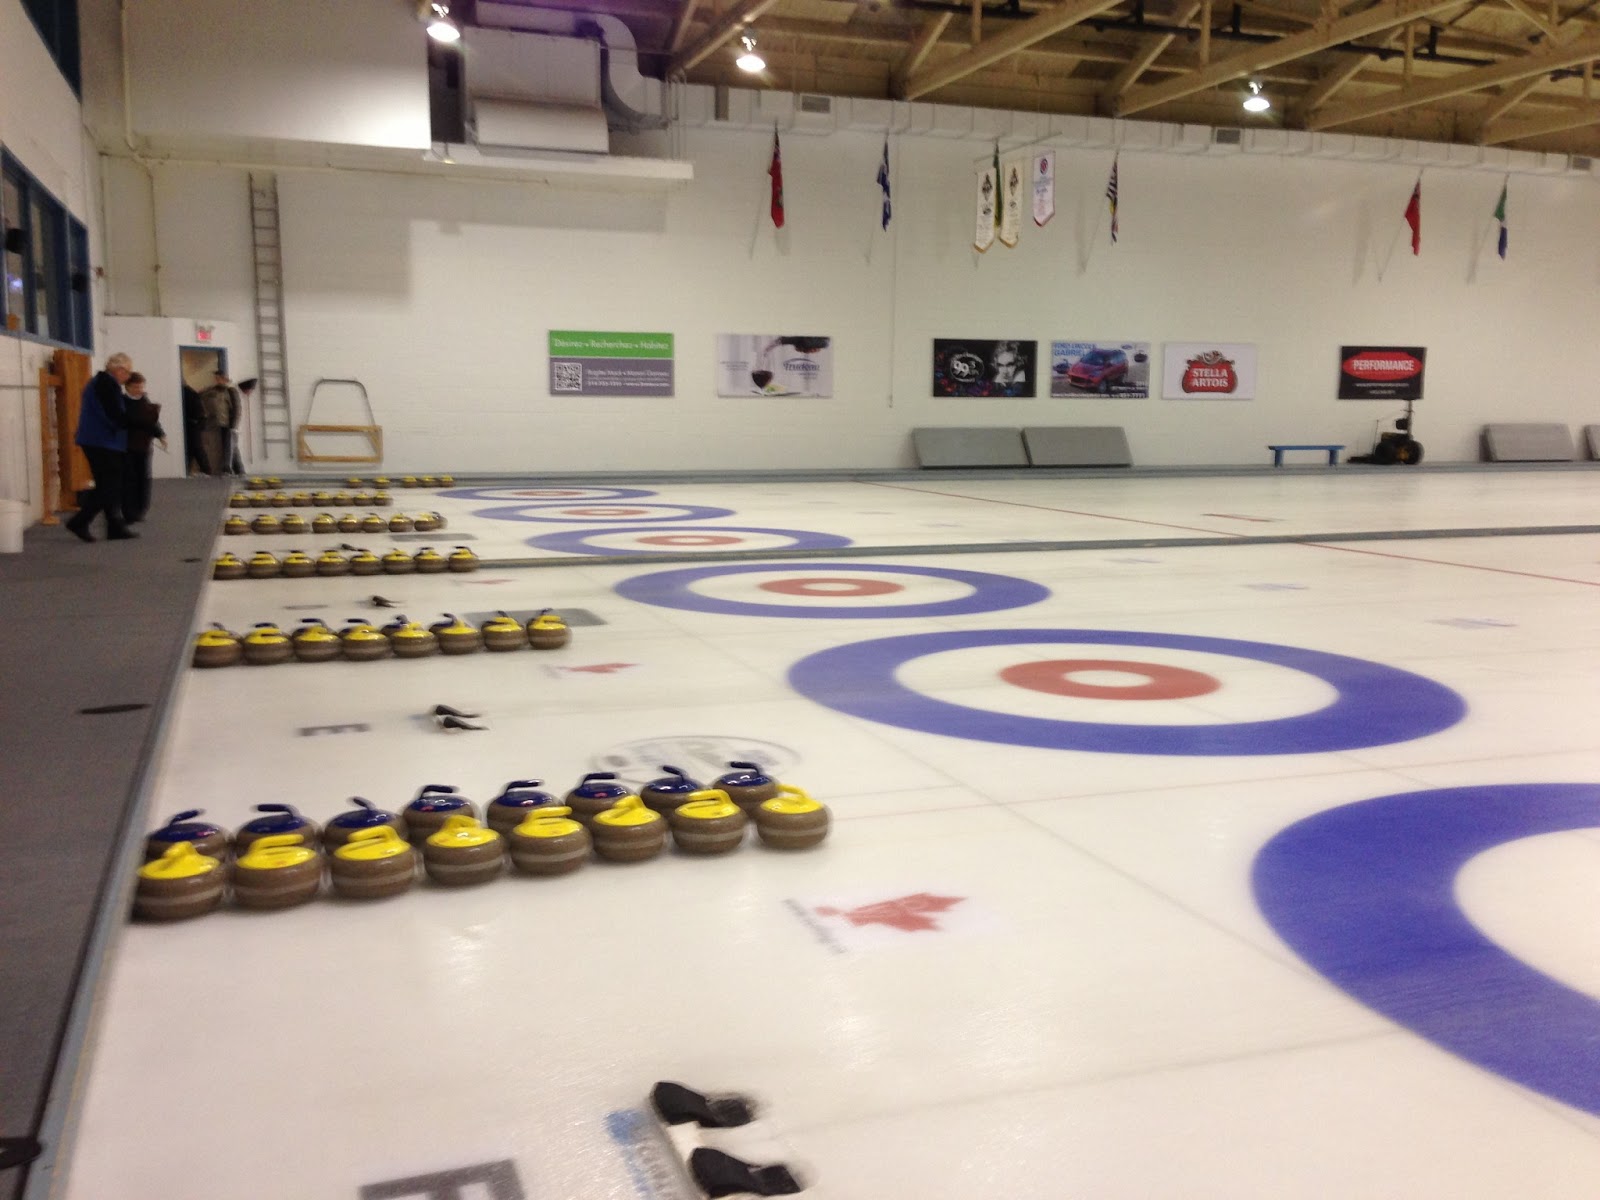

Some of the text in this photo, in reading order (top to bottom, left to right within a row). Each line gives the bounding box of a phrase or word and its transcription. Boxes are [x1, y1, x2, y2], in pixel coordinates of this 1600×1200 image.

[1353, 359, 1415, 371] PERFORMANCE
[1192, 368, 1229, 378] STELLA
[1192, 378, 1229, 388] ARTOIS
